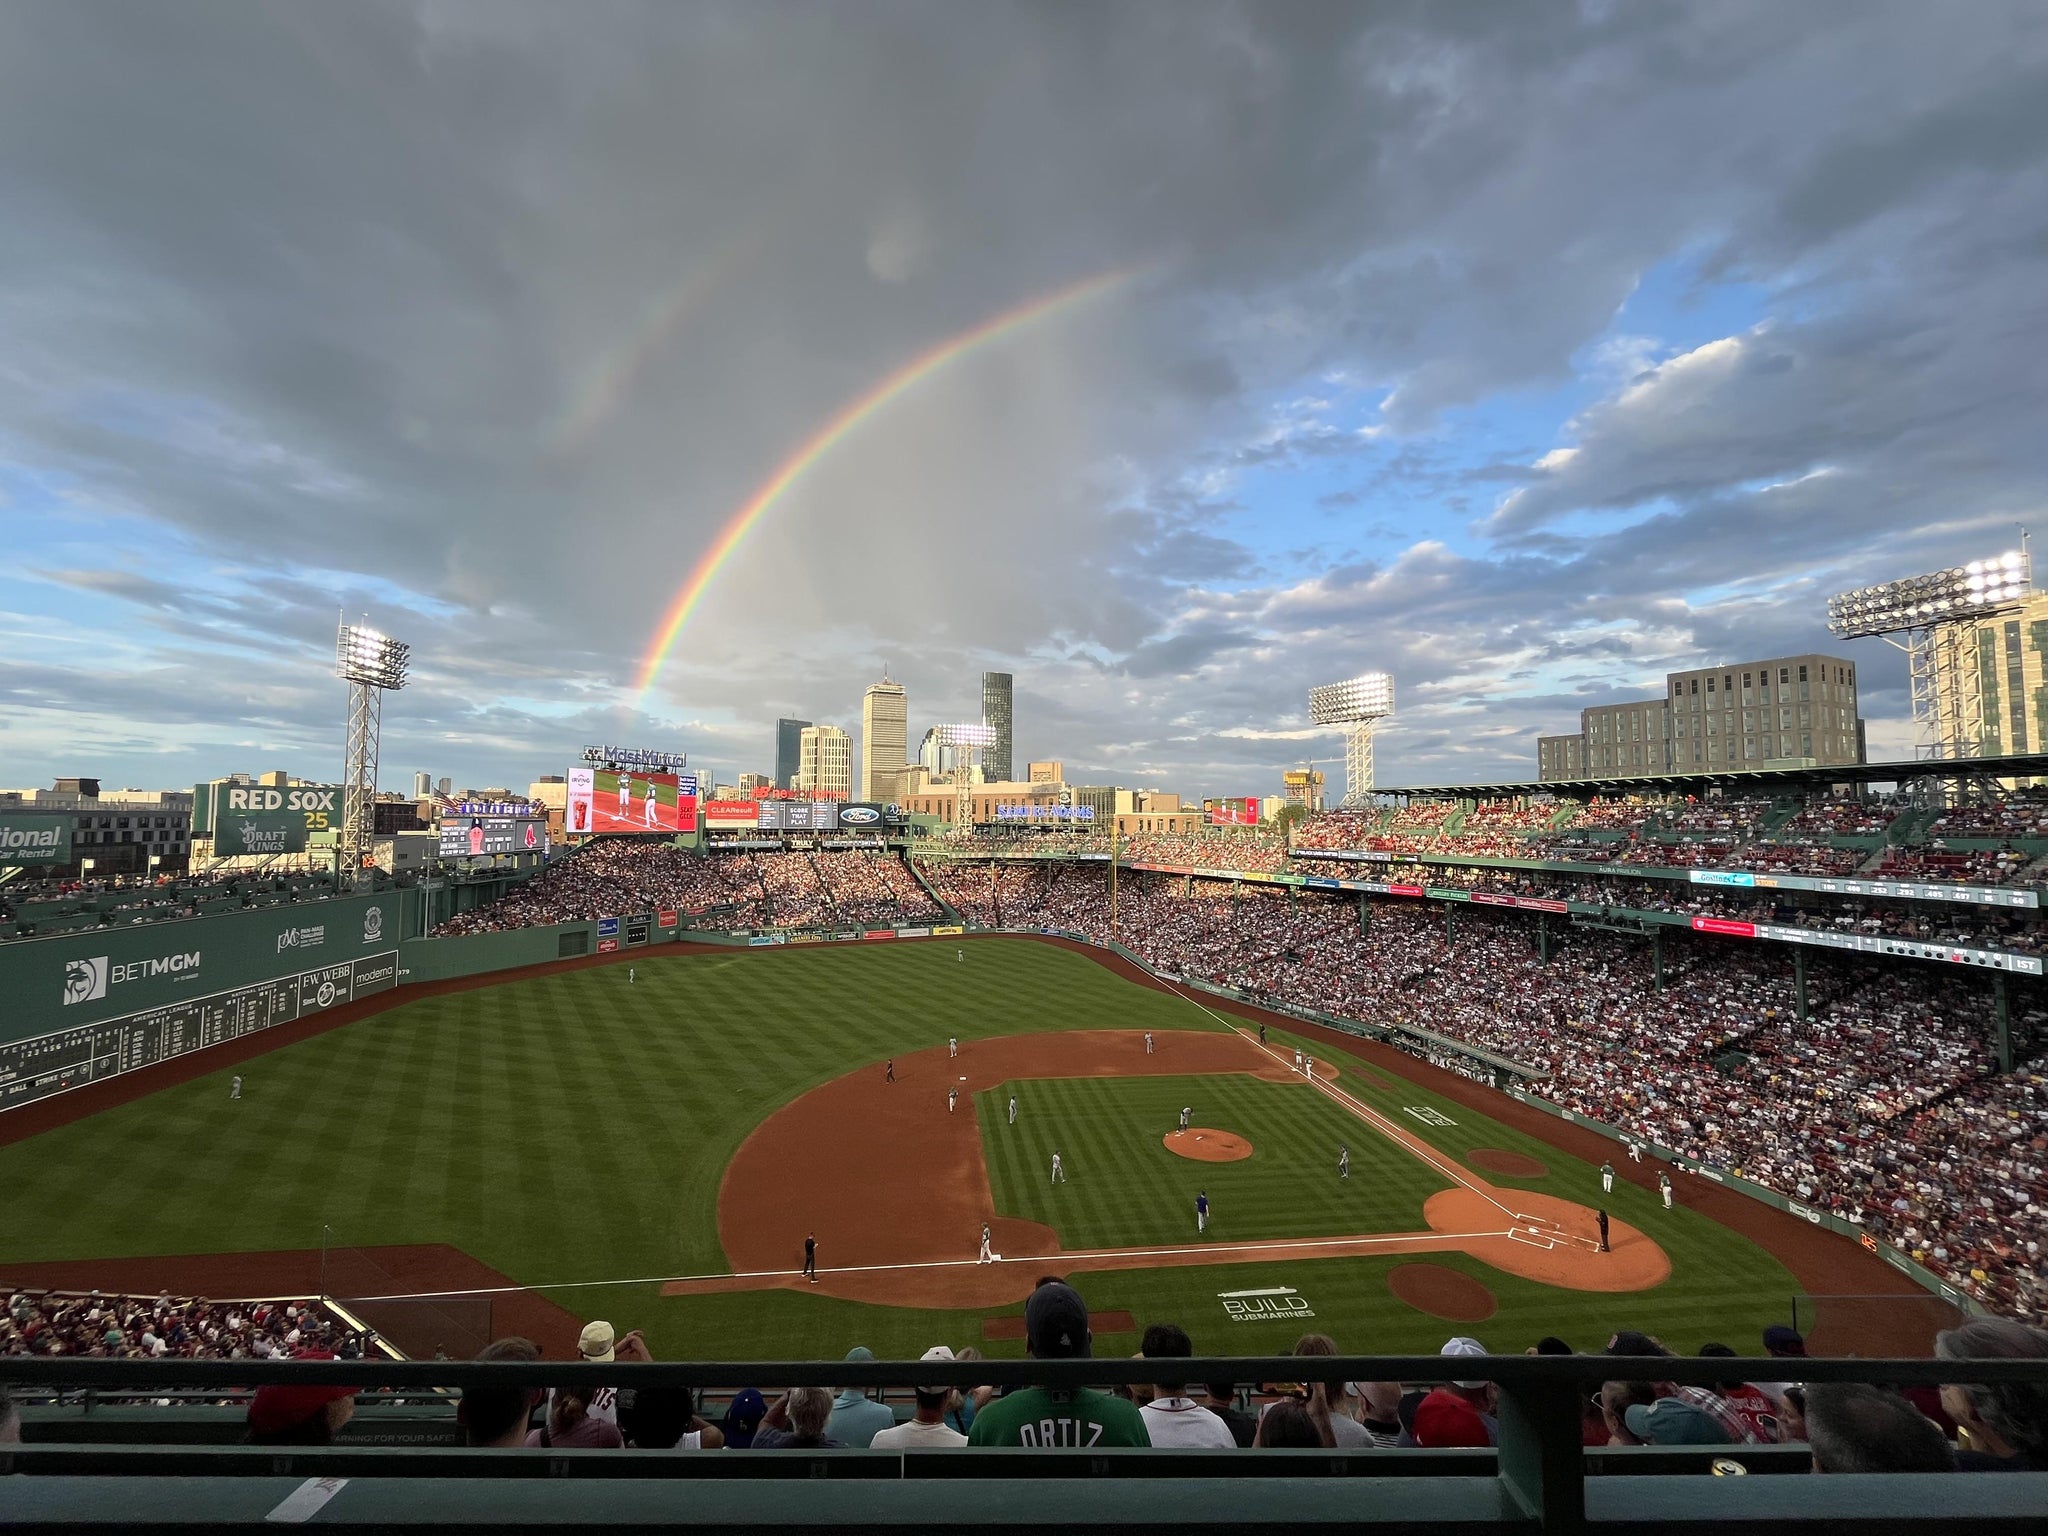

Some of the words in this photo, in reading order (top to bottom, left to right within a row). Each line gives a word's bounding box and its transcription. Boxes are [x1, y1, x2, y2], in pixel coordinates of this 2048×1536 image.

[602, 744, 686, 767] MassMutual
[229, 789, 283, 810] RED
[287, 790, 335, 811] SOX
[848, 809, 871, 821] Ford
[997, 805, 1048, 819] SAMUEL
[1050, 804, 1094, 819] ADAMS
[303, 812, 329, 829] 25
[0, 826, 63, 848] ional.
[242, 831, 287, 844] DRAFT
[17, 848, 56, 859] Rental
[246, 841, 285, 852] KINGS
[111, 951, 200, 984] BETMGM
[322, 965, 351, 982] WEBB
[355, 966, 393, 984] moderna
[231, 989, 256, 997] NATIONAL
[258, 983, 277, 992] LEAGUE
[132, 1010, 167, 1022] AMERICAN
[168, 1004, 192, 1014] LEAGUE
[2, 1038, 56, 1055] FENWAY
[64, 1028, 95, 1040] PARK
[9, 1084, 28, 1094] BALL
[35, 1074, 59, 1086] STRIKE
[60, 1070, 76, 1078] OUT
[1222, 1296, 1309, 1314] BUILD
[1231, 1310, 1316, 1322] SUBMARINES
[335, 1434, 372, 1442] ARNING:
[374, 1434, 394, 1442] FOR
[396, 1434, 424, 1442] YOUR
[426, 1434, 456, 1442] SAFET
[1020, 1418, 1103, 1448] ORTIZ
